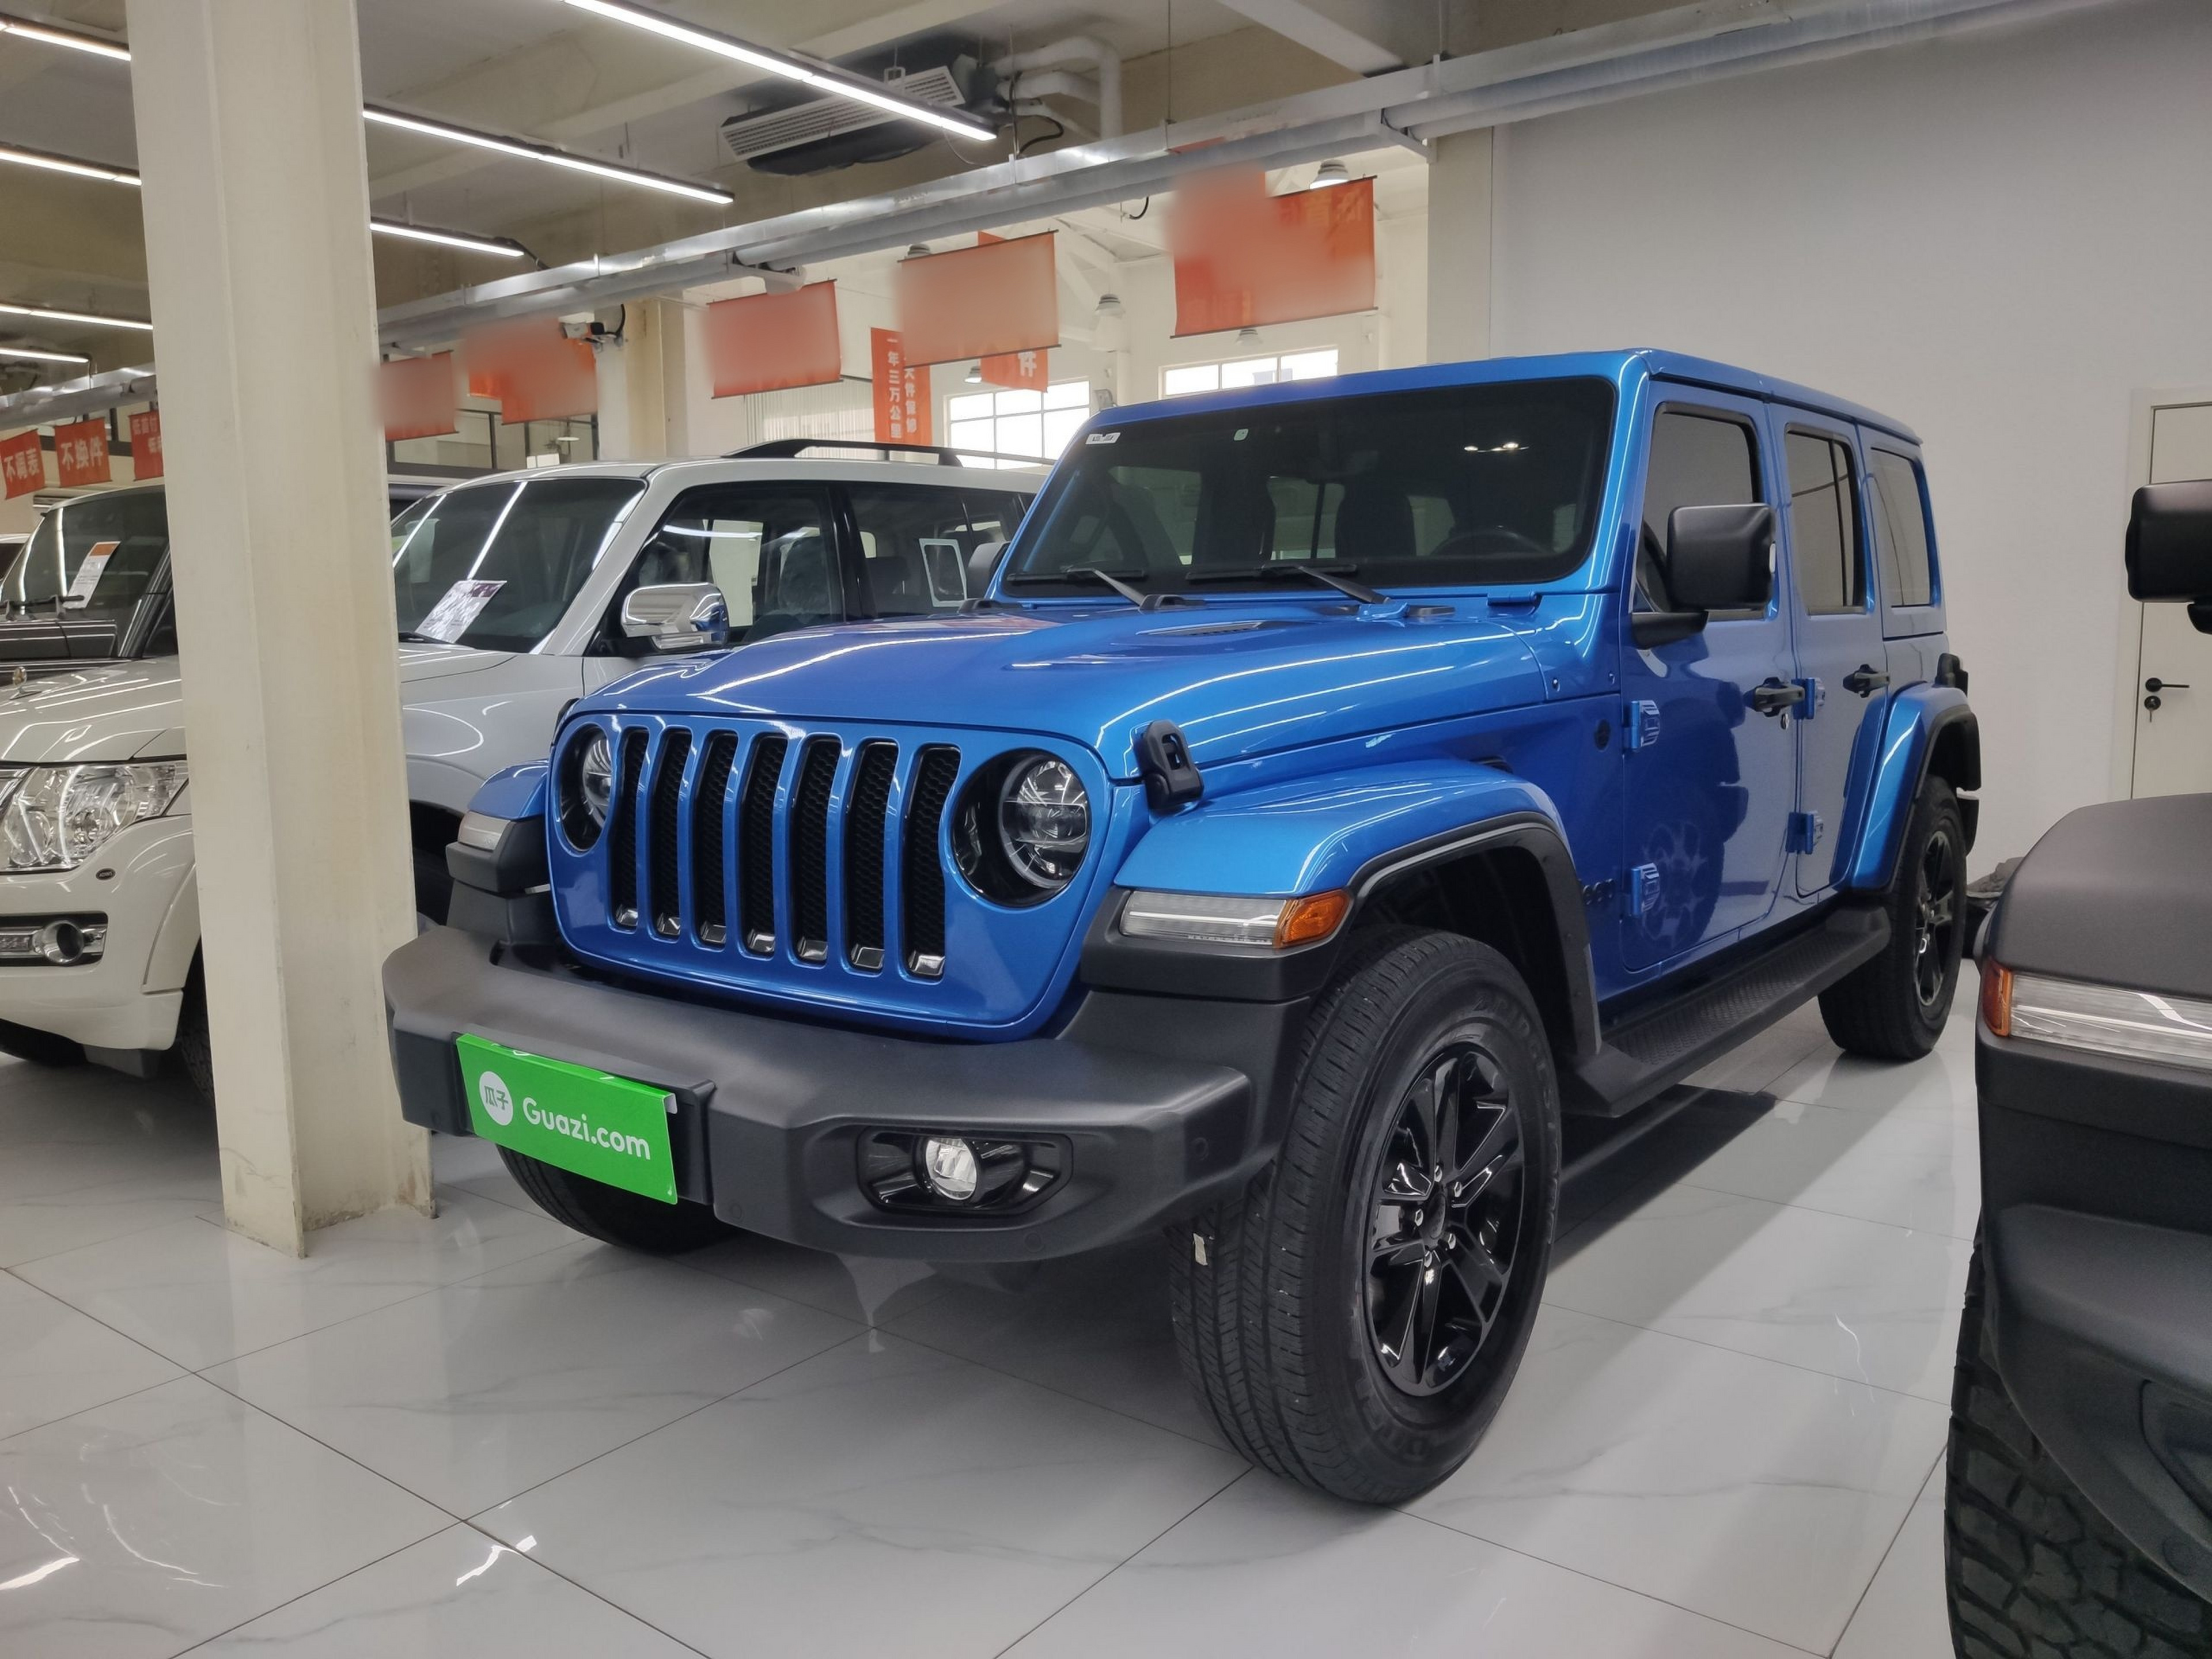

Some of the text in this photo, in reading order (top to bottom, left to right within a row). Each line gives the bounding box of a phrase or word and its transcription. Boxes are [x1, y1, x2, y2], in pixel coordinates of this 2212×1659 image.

[886, 338, 902, 439] 一年三万公里
[60, 435, 104, 471] 不换件
[483, 1085, 509, 1111] 瓜子
[522, 1097, 652, 1160] Guazi.com
